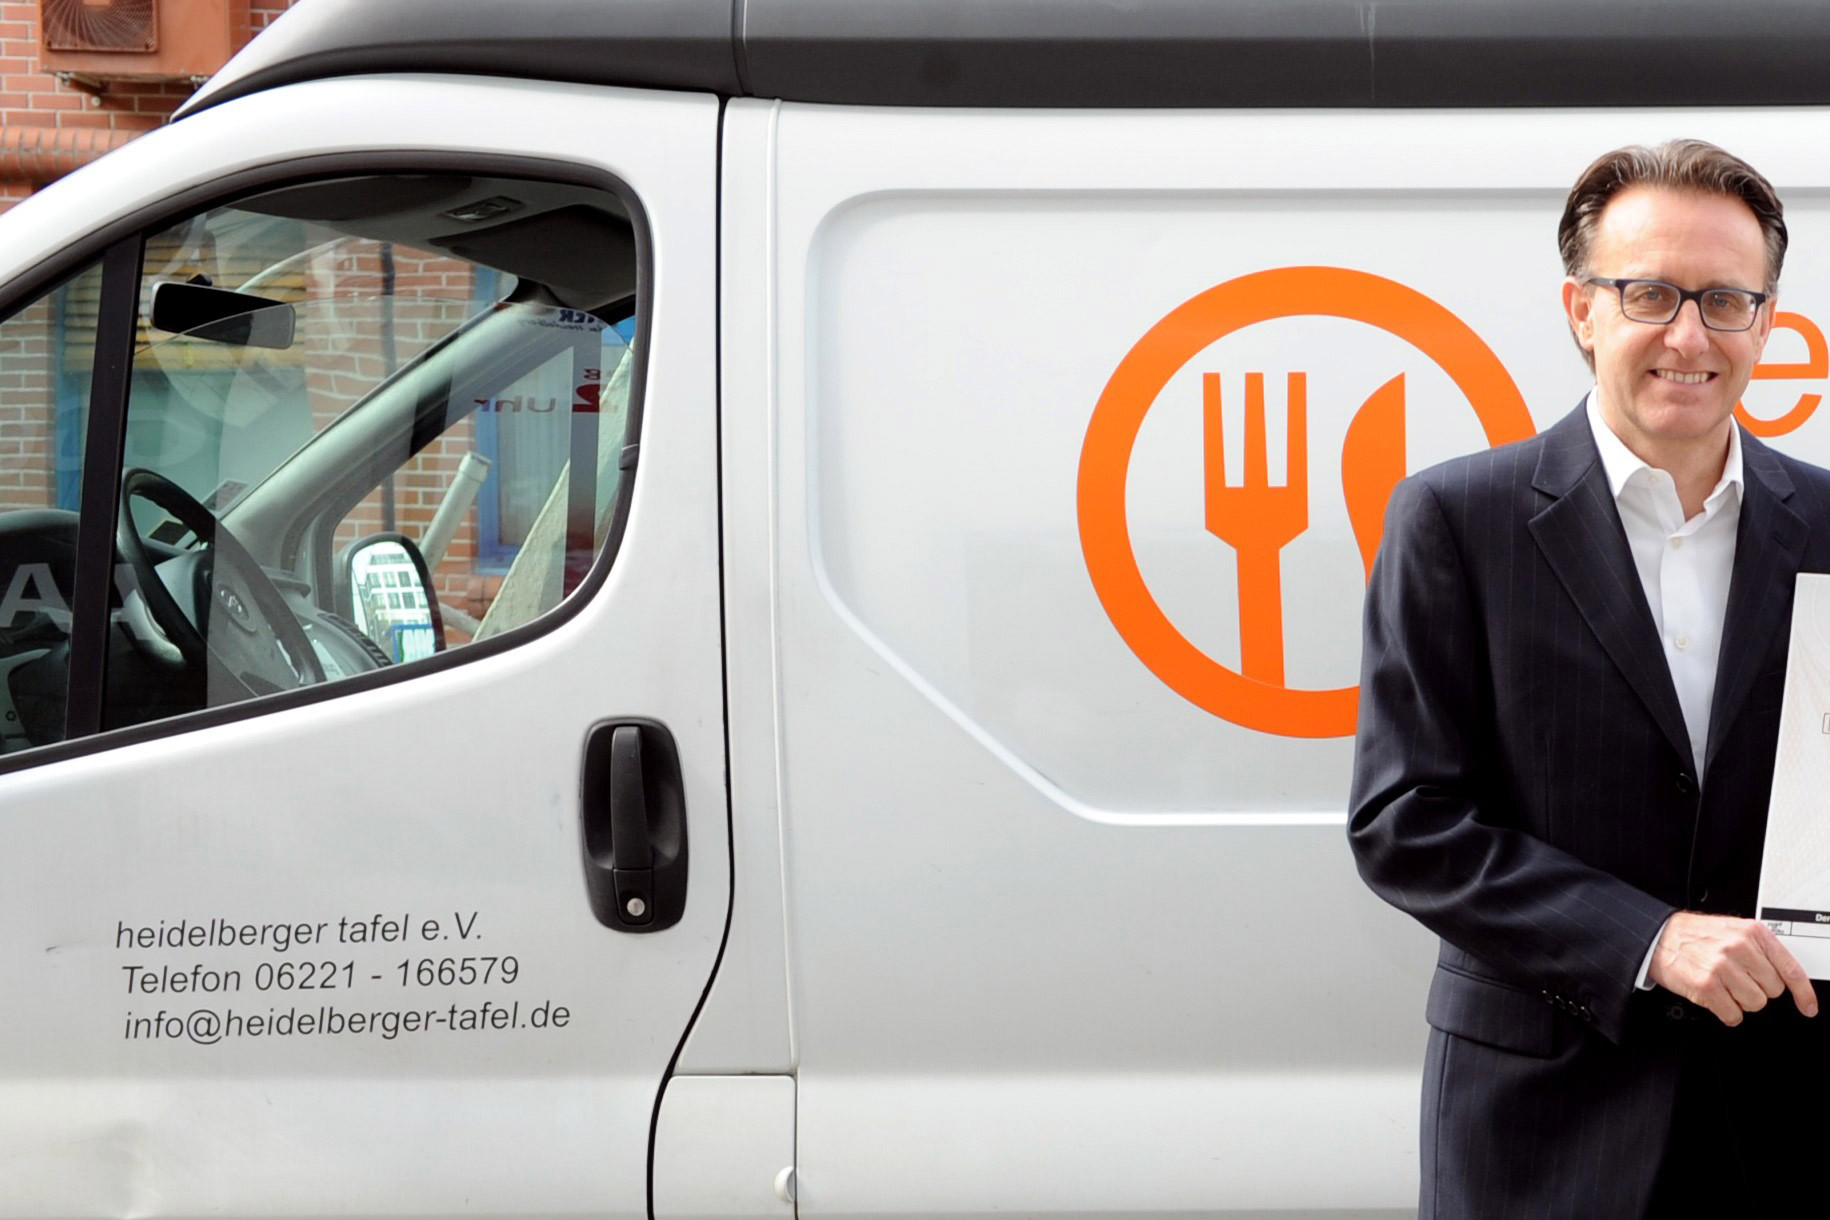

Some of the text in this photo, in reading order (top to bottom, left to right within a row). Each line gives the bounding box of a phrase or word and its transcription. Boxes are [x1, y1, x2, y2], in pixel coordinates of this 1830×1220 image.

[115, 911, 483, 953] heidelberger tafel e.V.
[122, 963, 242, 994] Telefon
[254, 960, 357, 992] 06221
[396, 955, 520, 987] 166579
[123, 999, 572, 1045] info@heidelberger-tafel.de
